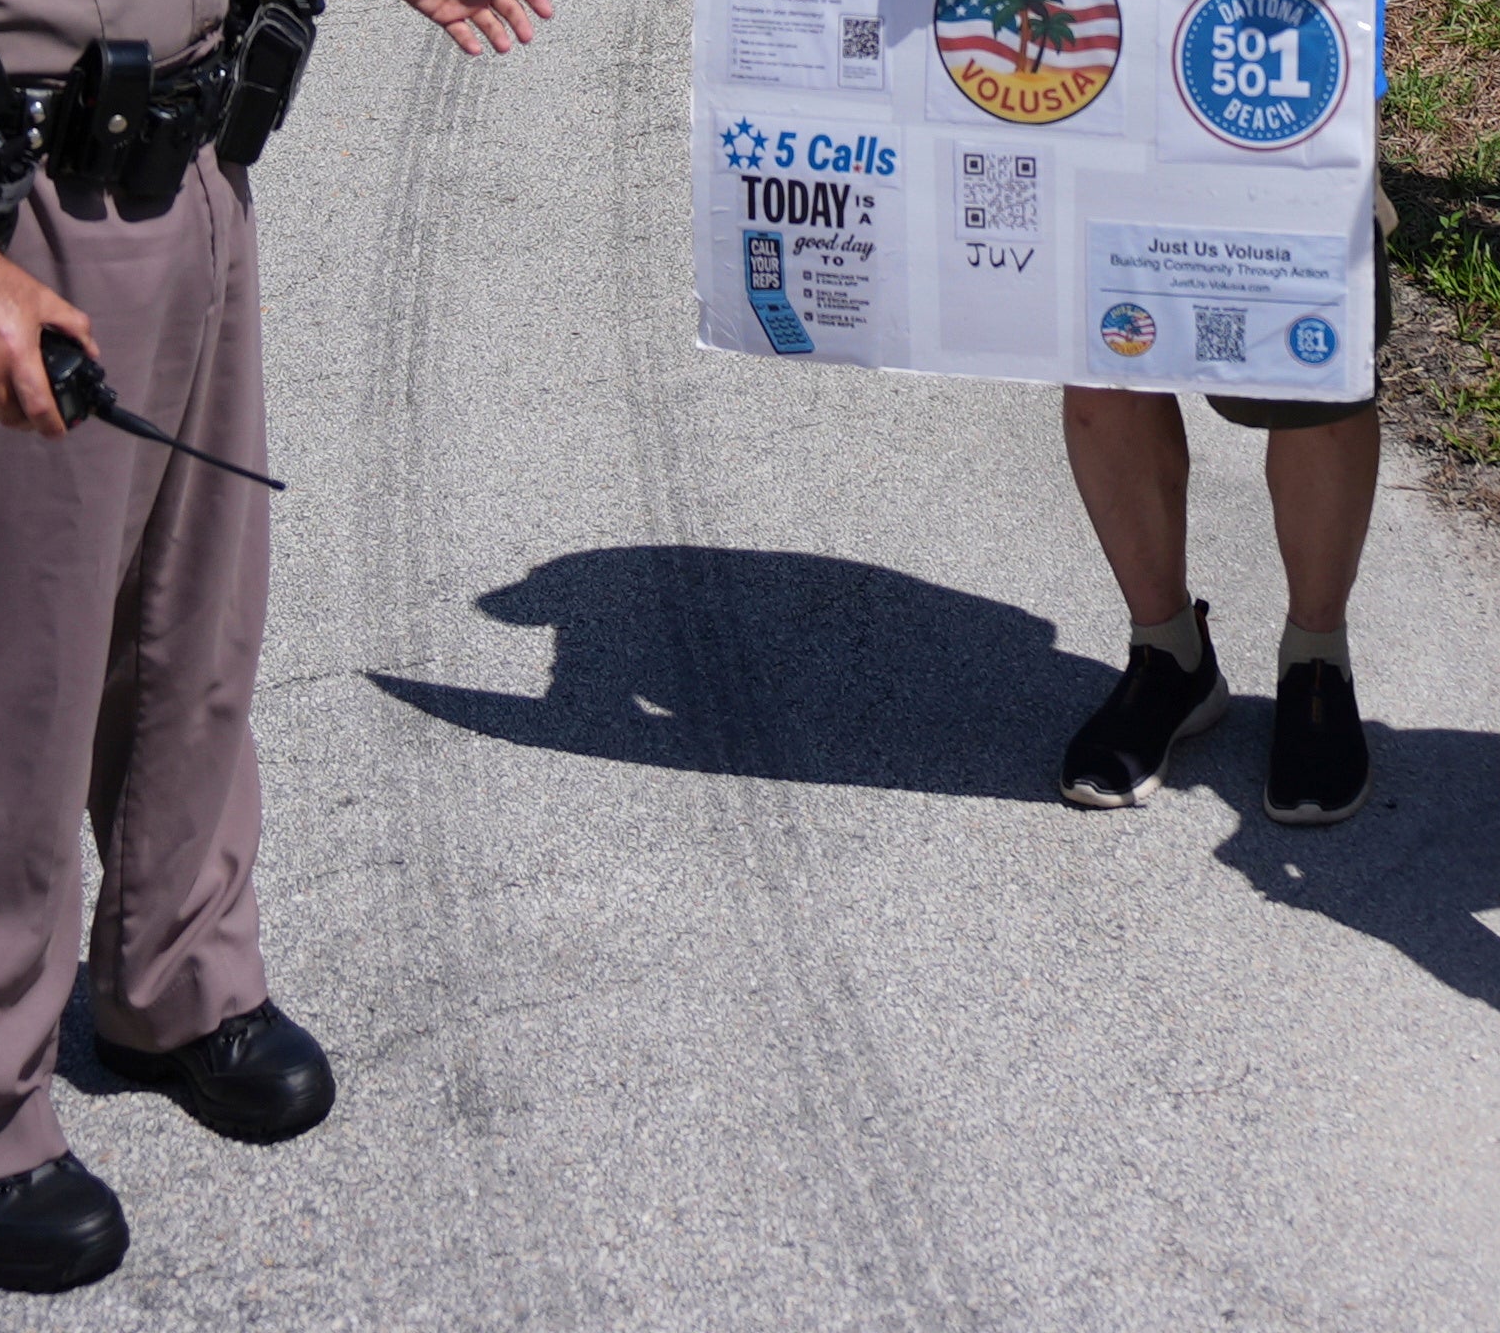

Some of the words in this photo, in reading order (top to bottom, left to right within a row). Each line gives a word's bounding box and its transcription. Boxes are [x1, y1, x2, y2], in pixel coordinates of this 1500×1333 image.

[1210, 25, 1268, 61] 50
[1211, 61, 1267, 98] 50
[1267, 27, 1312, 99] 1
[958, 57, 1097, 115] VOLUSIA
[1222, 97, 1298, 131] BEACH
[774, 131, 798, 169] 5
[740, 174, 852, 230] TODAY
[855, 194, 875, 210] IS
[858, 212, 873, 226] A
[750, 238, 778, 256] CALL
[792, 232, 840, 257] good
[840, 235, 877, 262] day
[820, 254, 845, 268] TO
[1148, 238, 1188, 256] Just
[1194, 241, 1219, 259] Us
[1224, 244, 1291, 263] Volusia
[749, 255, 780, 273] YOUR
[1109, 253, 1161, 272] Building
[1163, 258, 1233, 277] Community
[1237, 263, 1288, 280] Through
[1290, 265, 1330, 280] Action
[751, 271, 781, 290] REPS
